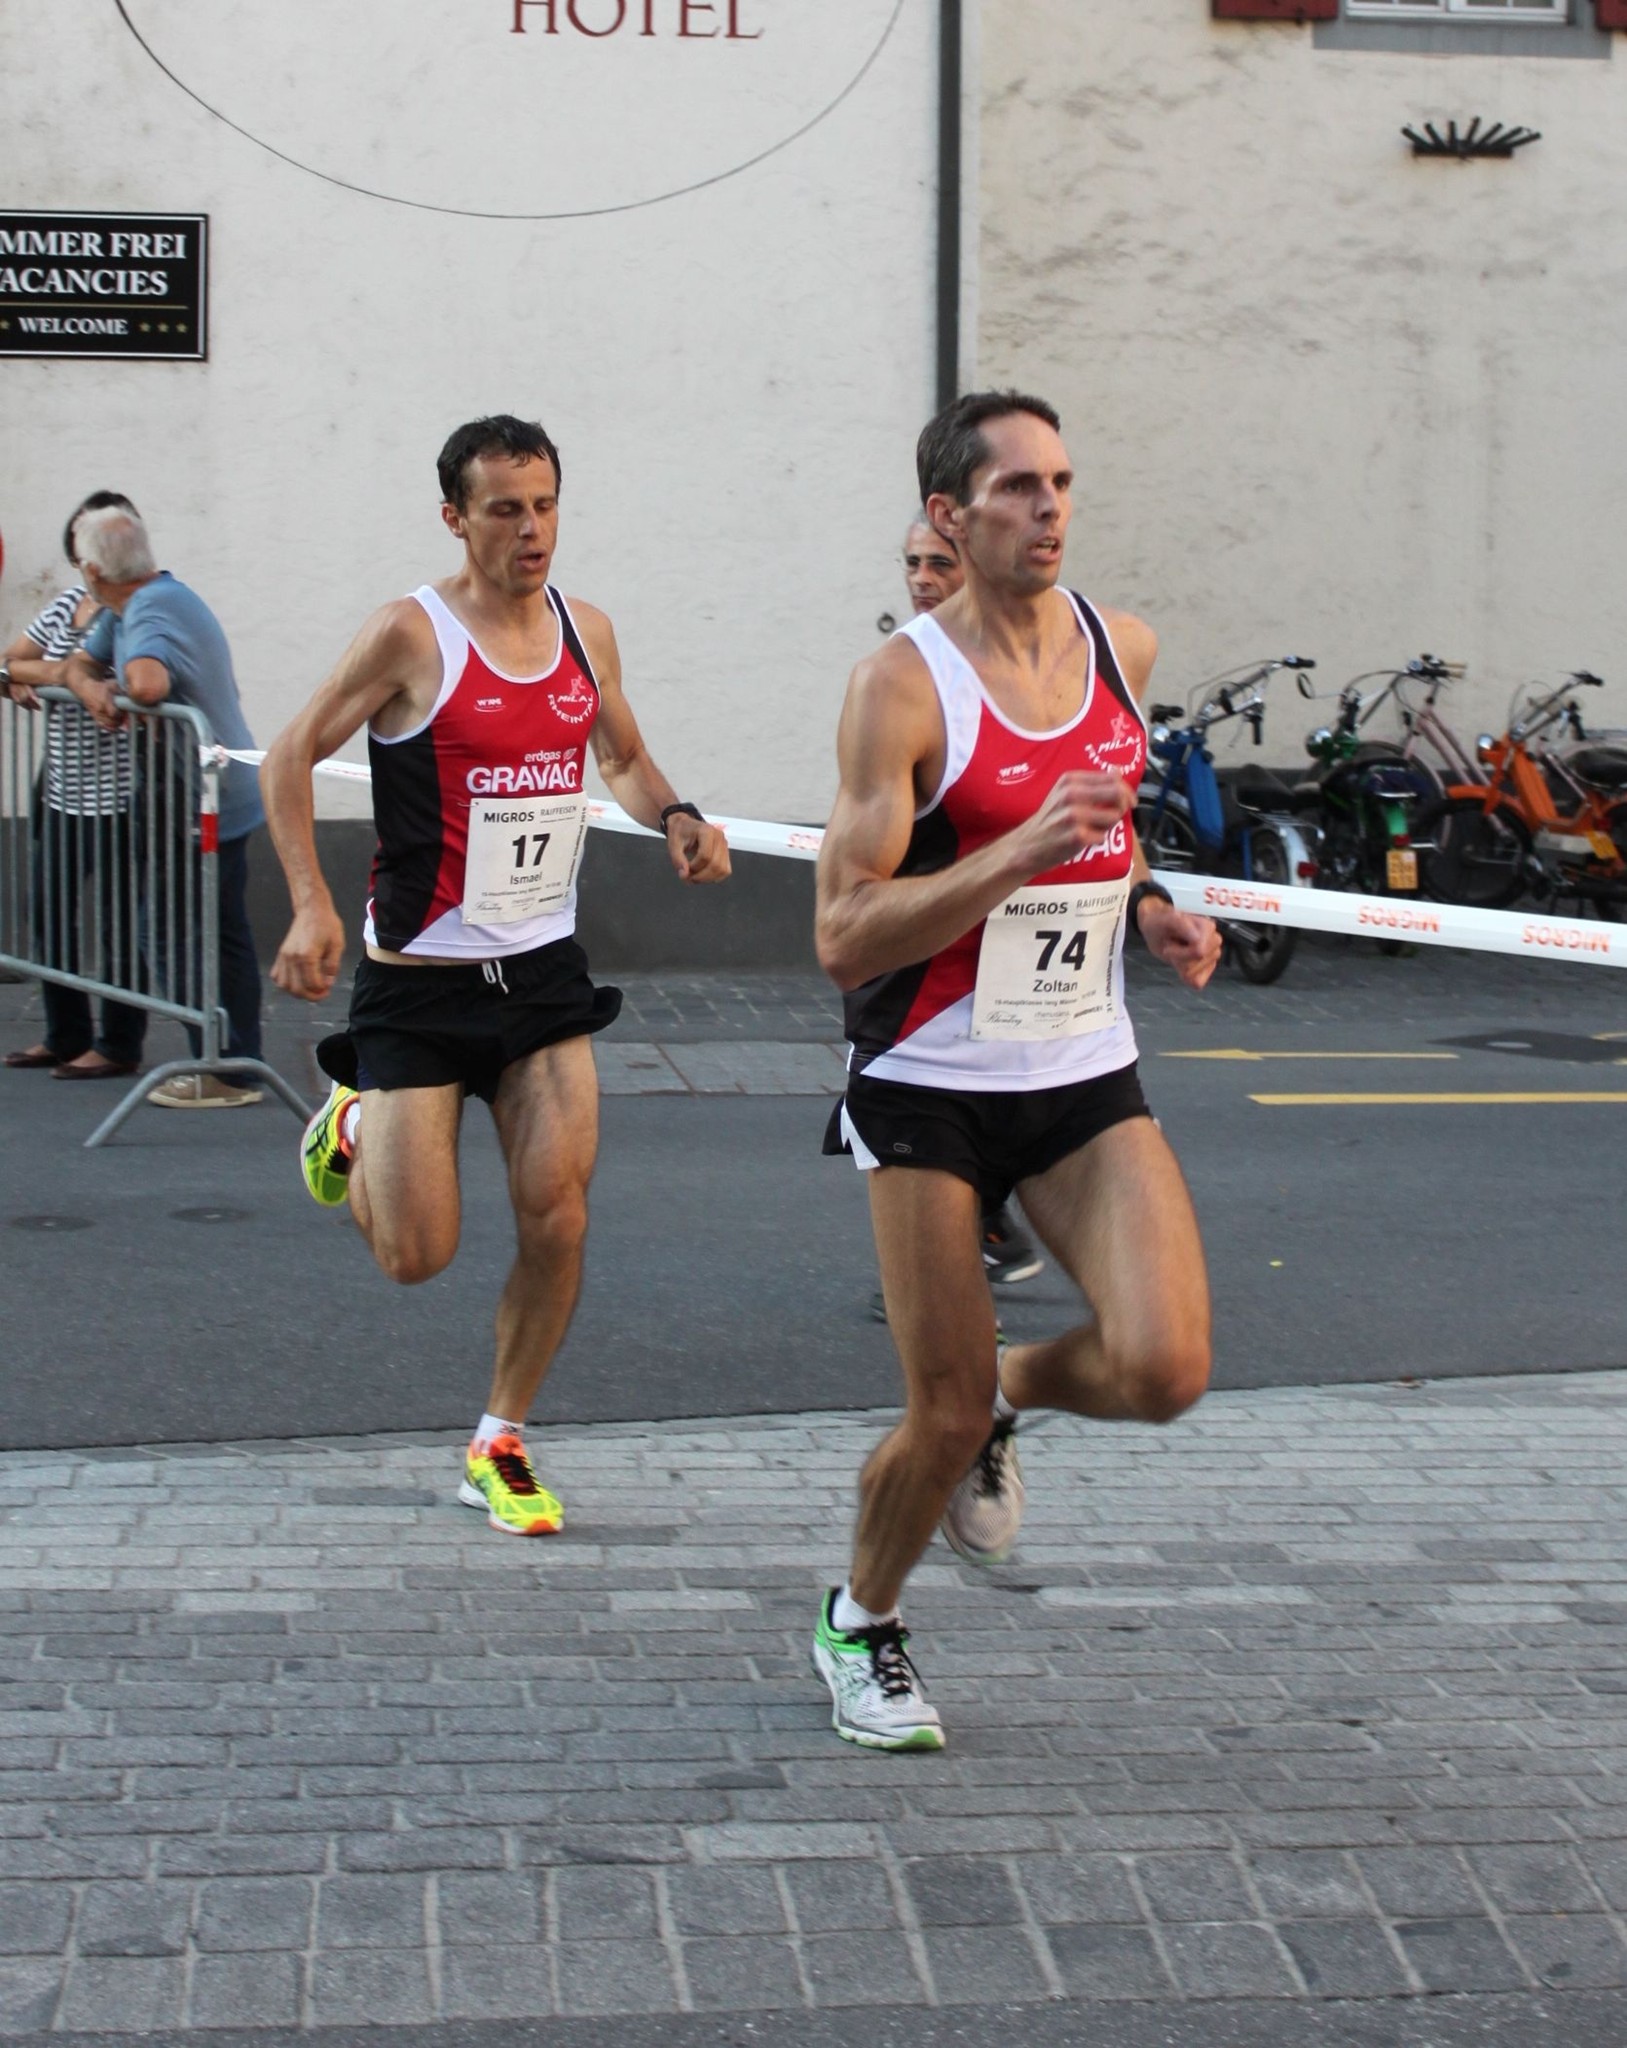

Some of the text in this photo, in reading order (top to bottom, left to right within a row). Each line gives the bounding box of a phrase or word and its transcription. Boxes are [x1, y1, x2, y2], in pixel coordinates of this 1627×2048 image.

[510, 0, 765, 38] HOTEL
[109, 232, 187, 259] FREI
[0, 268, 169, 296] ACANCIES
[18, 316, 129, 335] WELCOME
[524, 750, 561, 763] erdgas
[466, 761, 578, 793] GRAVAG
[483, 811, 535, 823] MIGROS
[512, 833, 551, 868] 17
[510, 871, 543, 885] Ismael
[1004, 901, 1069, 917] MIGROS
[1203, 886, 1282, 913] MIGROS
[1357, 904, 1441, 932] MIGROS
[1034, 930, 1088, 971] 74
[1522, 924, 1611, 953] MIGROS
[1033, 979, 1078, 993] Zoltan
